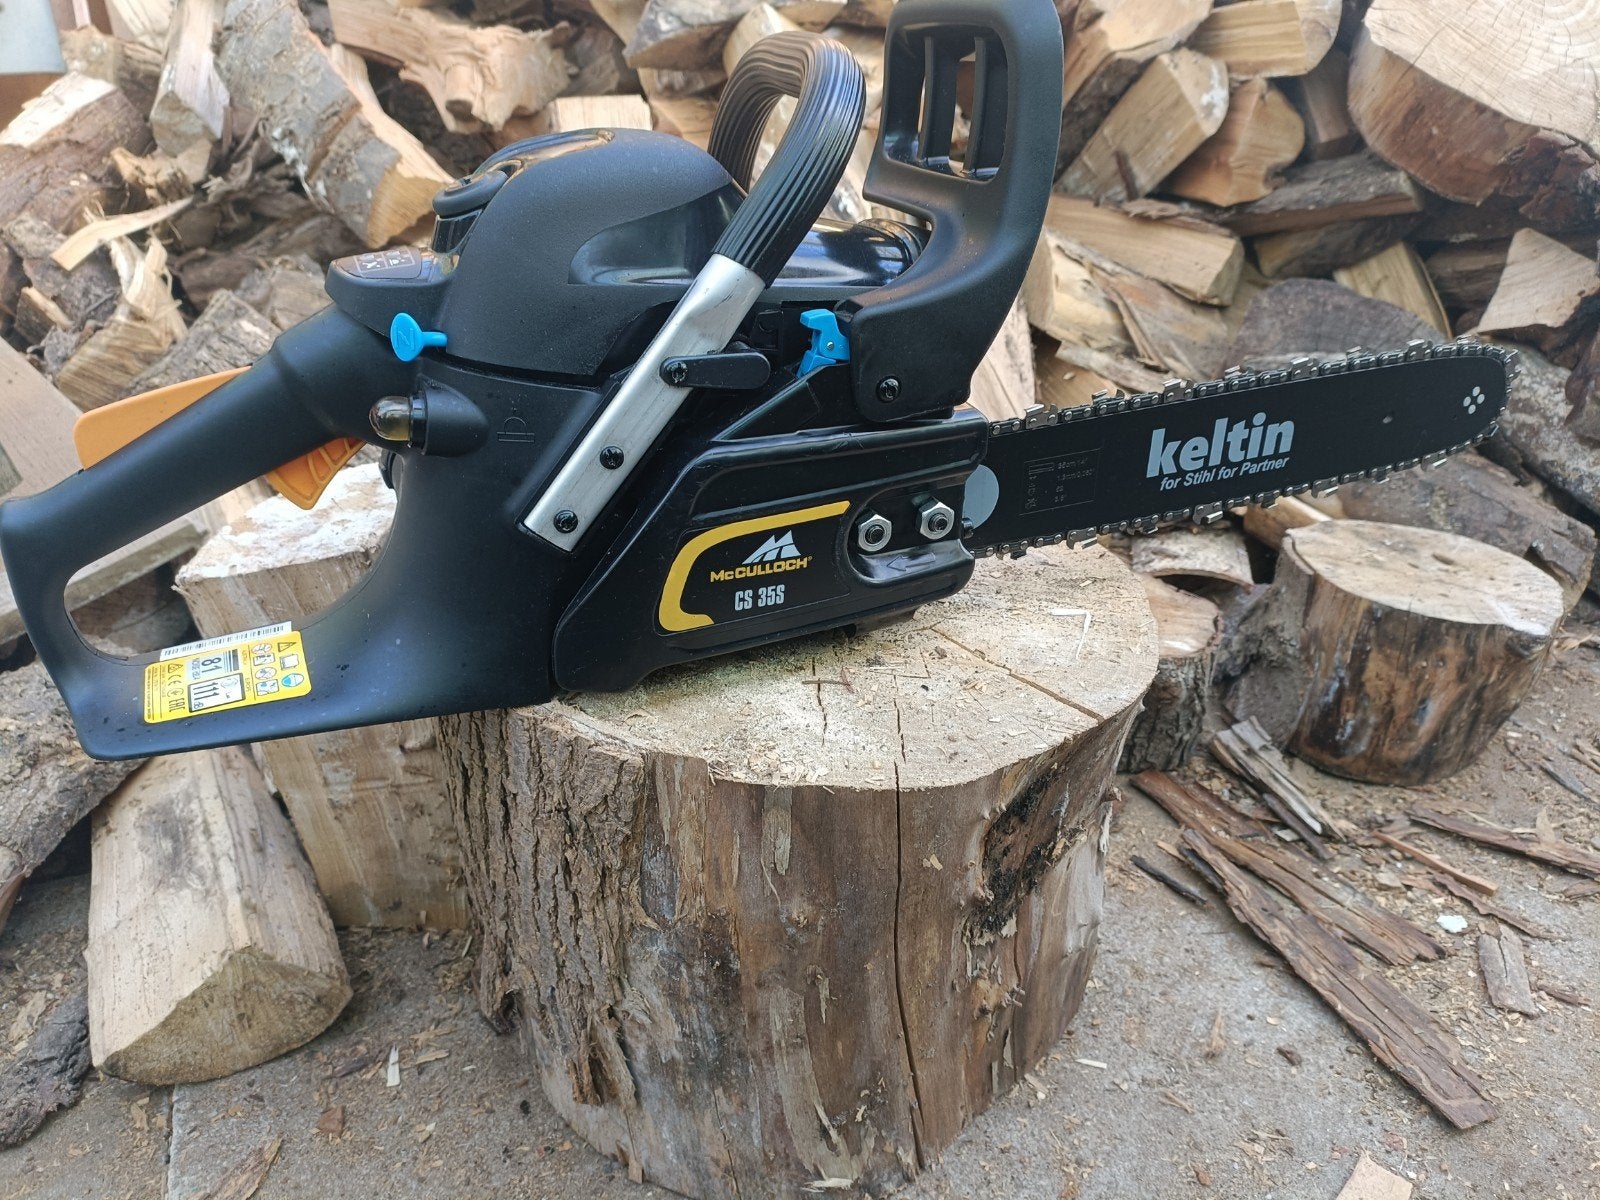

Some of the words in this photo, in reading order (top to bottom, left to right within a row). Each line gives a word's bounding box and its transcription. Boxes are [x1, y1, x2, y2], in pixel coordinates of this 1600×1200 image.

[1146, 412, 1295, 478] keltin
[1160, 475, 1178, 491] for
[1184, 468, 1215, 488] Stihl
[1217, 466, 1233, 482] for
[1239, 457, 1290, 477] Partner
[734, 589, 753, 611] CS
[758, 584, 786, 607] 35S
[201, 657, 222, 673] 81
